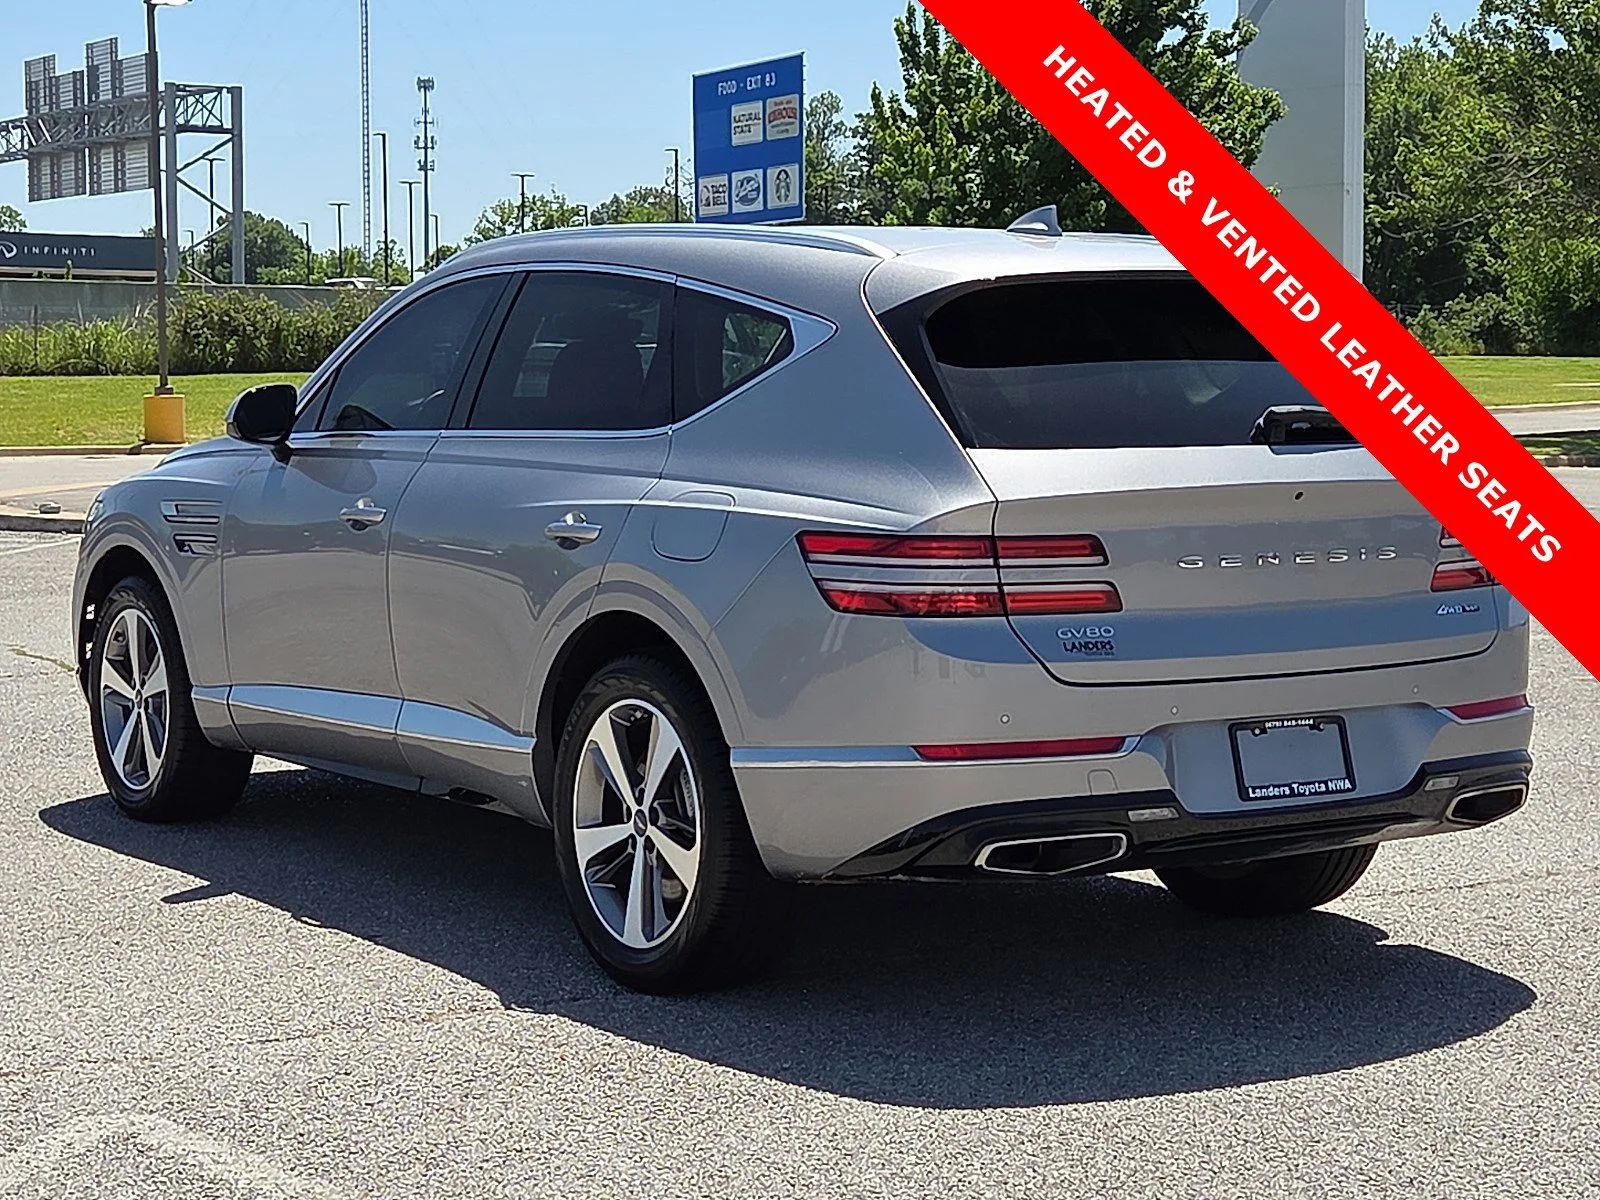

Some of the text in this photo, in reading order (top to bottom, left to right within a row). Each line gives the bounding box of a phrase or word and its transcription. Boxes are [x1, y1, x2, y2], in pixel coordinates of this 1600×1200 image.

[717, 80, 737, 96] FOOD
[746, 74, 762, 91] EXIT
[733, 111, 762, 124] NATURAL
[733, 123, 752, 136] STATE
[710, 183, 727, 195] TACO
[712, 195, 728, 207] BELL
[23, 245, 96, 257] INFINITI
[1177, 546, 1398, 569] GENESIS
[1057, 625, 1115, 639] GV80
[1062, 639, 1115, 653] LANDERS
[1248, 778, 1353, 798] Landers Toyota NWA
